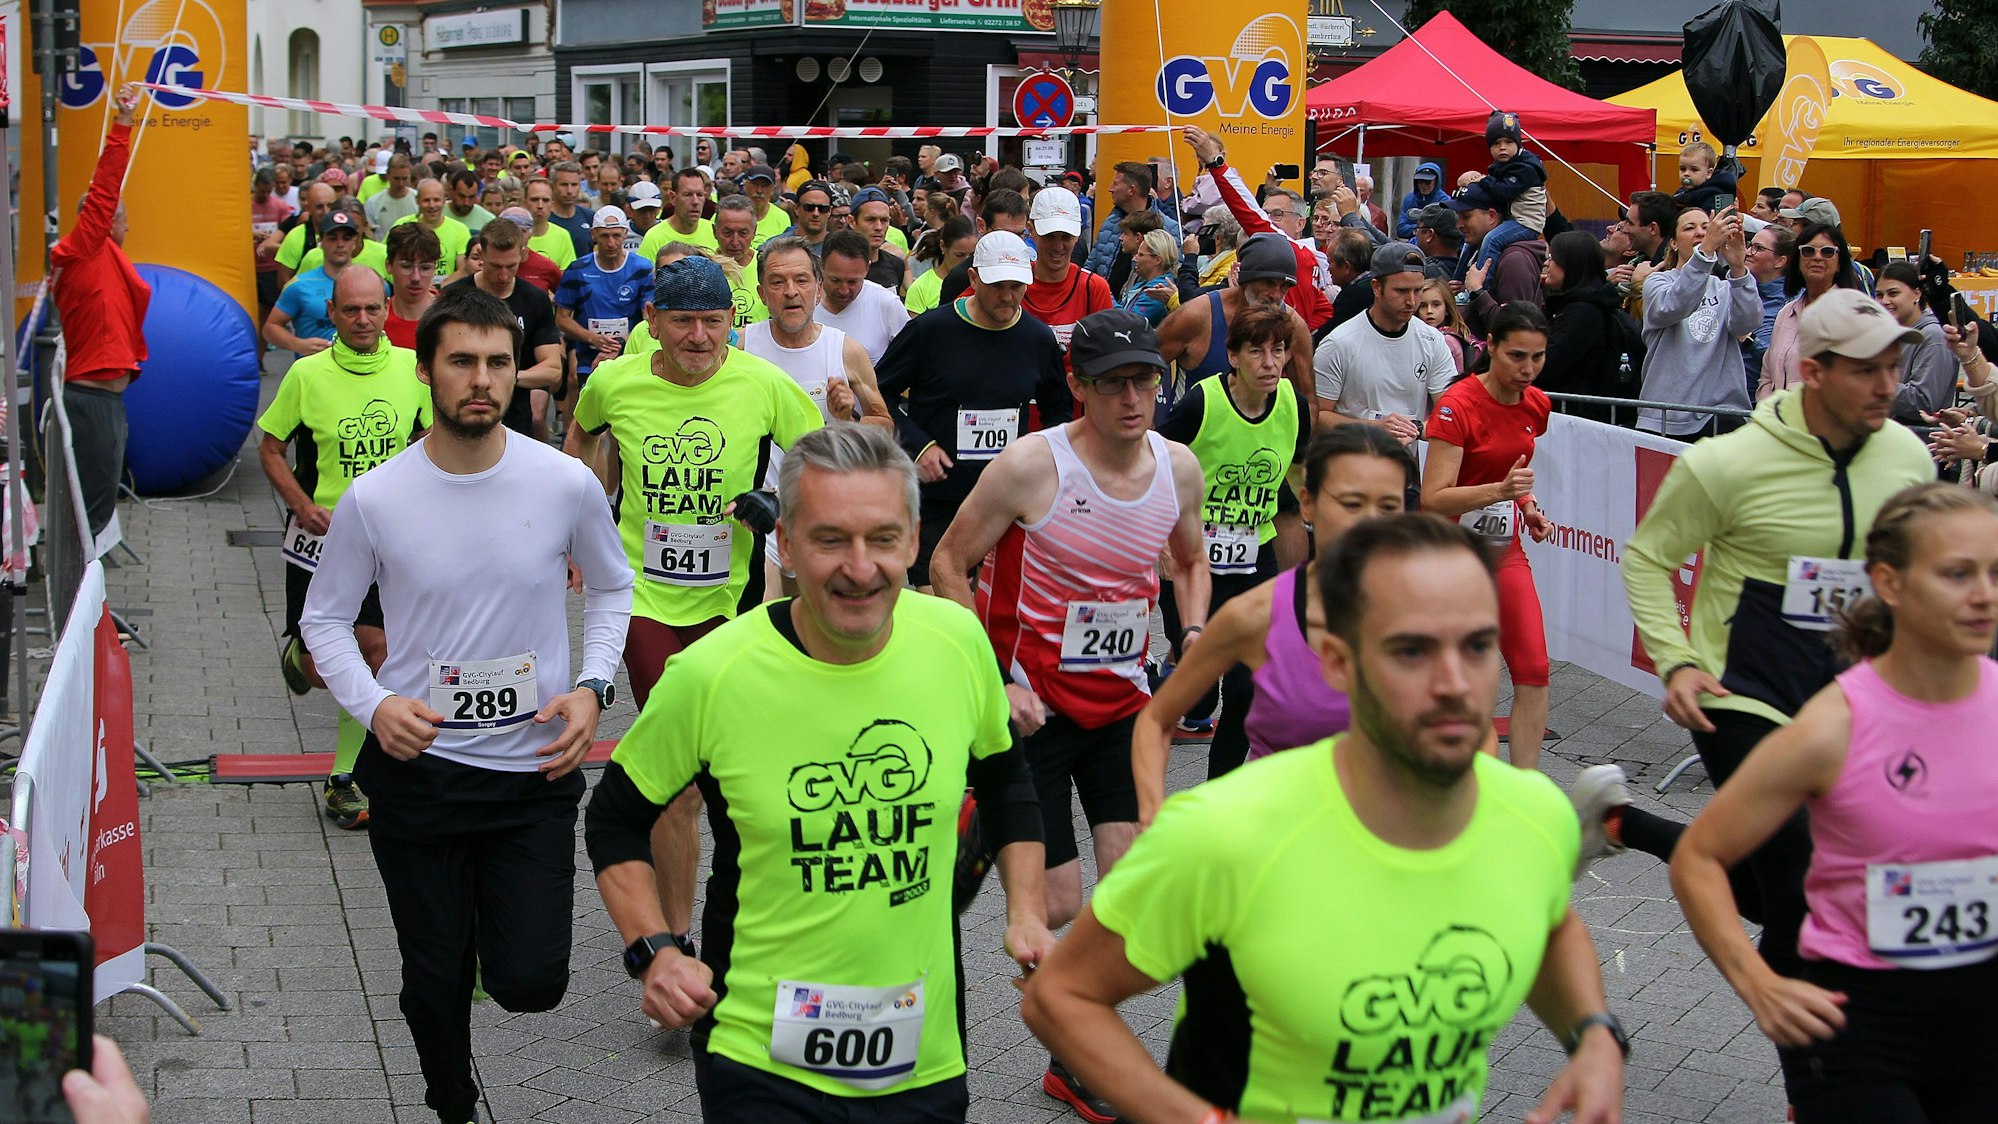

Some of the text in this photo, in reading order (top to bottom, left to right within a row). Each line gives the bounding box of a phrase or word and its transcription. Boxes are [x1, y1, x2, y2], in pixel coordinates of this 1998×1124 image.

[849, 14, 891, 22] Internationale
[939, 17, 976, 25] Lieferservice
[1155, 54, 1292, 120] GVG
[162, 114, 214, 131] Energie.
[1218, 122, 1296, 139] Meine Energie.
[1843, 137, 1960, 149] Ihr regionaler Energieversorger
[338, 415, 391, 440] GVG
[971, 429, 1008, 449] 709
[339, 437, 397, 460] LAUF
[642, 435, 714, 466] GVG
[339, 459, 389, 478] TEA
[642, 465, 724, 492] LAUF
[1216, 464, 1272, 485] GVG
[642, 491, 723, 516] TEAM
[1207, 485, 1276, 509] LAUF
[1205, 504, 1270, 526] TEAM
[1473, 514, 1507, 535] 406
[670, 532, 705, 541] GVG-Citylauf
[660, 547, 712, 573] 641
[1208, 543, 1247, 563] 612
[1081, 628, 1134, 656] 240
[462, 669, 504, 678] GVG-Citylauf
[453, 687, 518, 720] 289
[787, 754, 915, 813] GVG
[790, 802, 936, 853] LAUF
[790, 846, 930, 893] TEAM
[1903, 900, 1989, 945] 243
[825, 1001, 882, 1011] GVG-Citylauf
[1340, 973, 1491, 1037] GVG
[825, 1012, 863, 1022] Bedburg
[803, 1026, 894, 1067] 600
